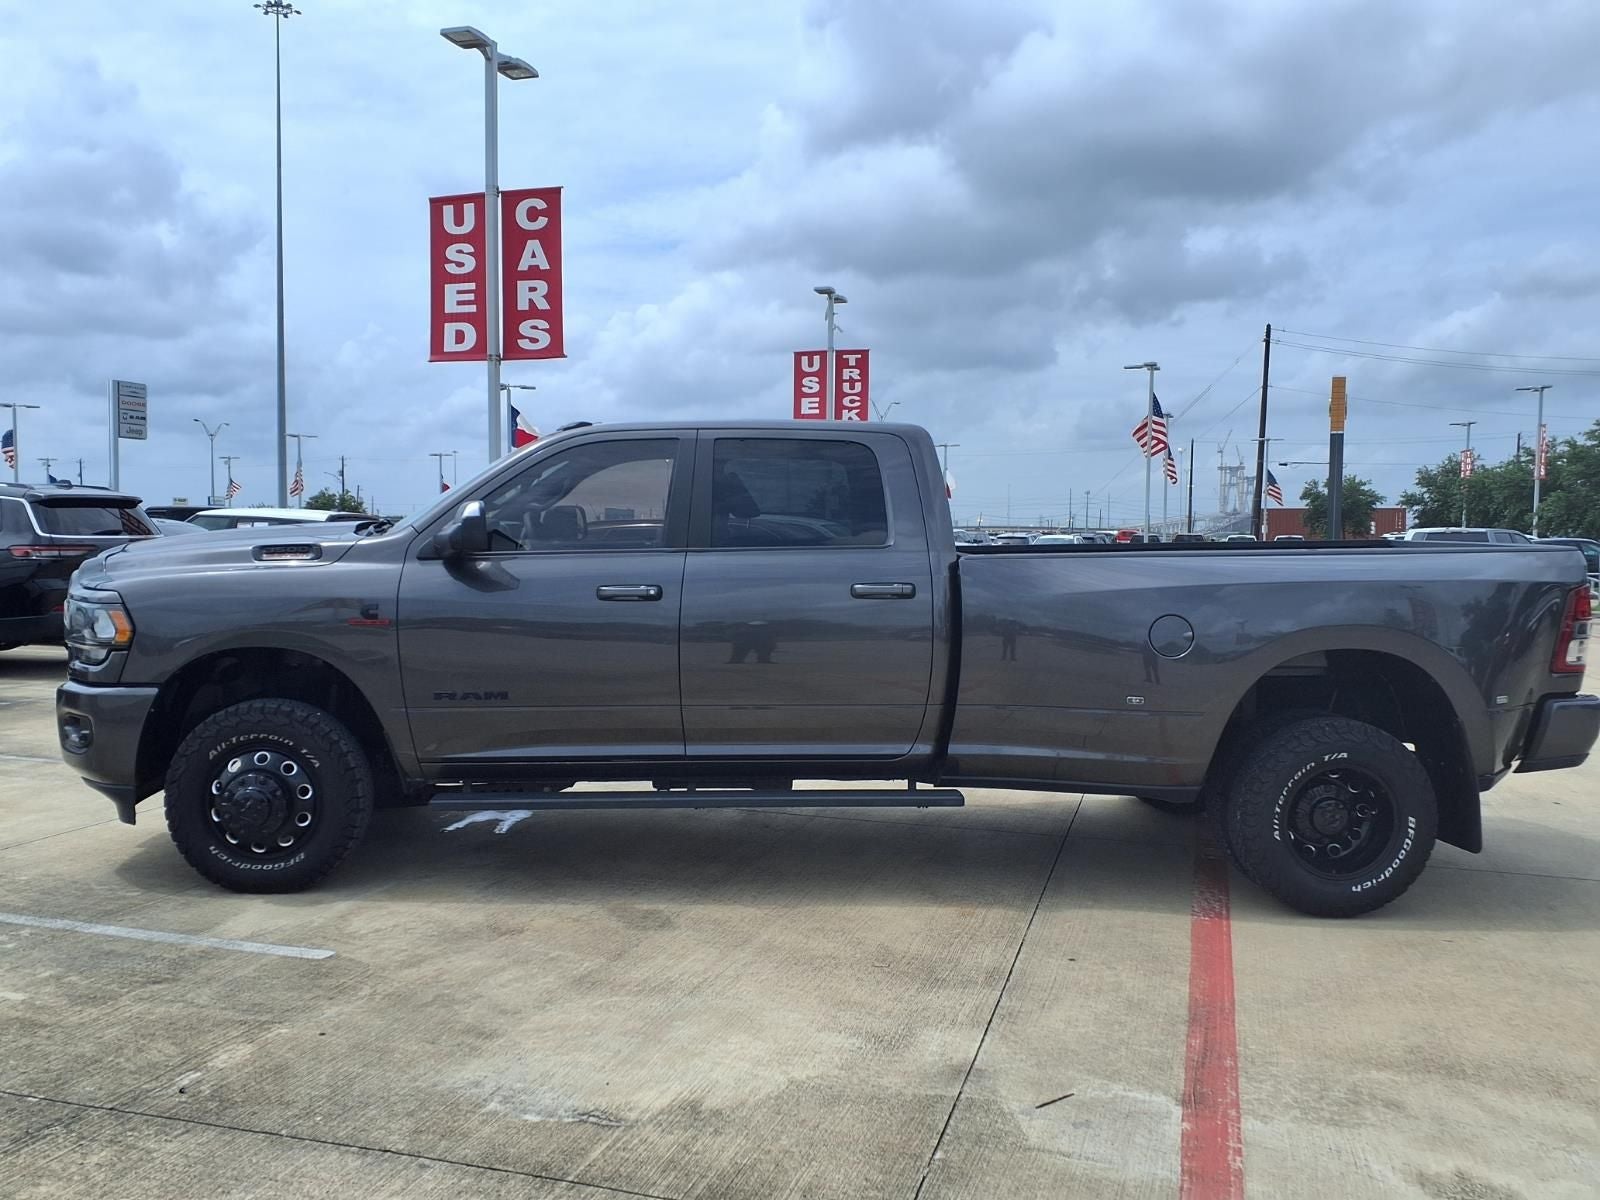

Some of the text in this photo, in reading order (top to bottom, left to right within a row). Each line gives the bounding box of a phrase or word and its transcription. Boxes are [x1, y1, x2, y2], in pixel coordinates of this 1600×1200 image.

[442, 202, 477, 352] USED
[515, 197, 551, 350] CARS
[800, 355, 821, 415] USE
[841, 353, 862, 421] TRUCK
[432, 691, 509, 701] RAM
[1272, 751, 1349, 841] All-Terrain T/A
[1351, 815, 1417, 893] BFGoodrich
